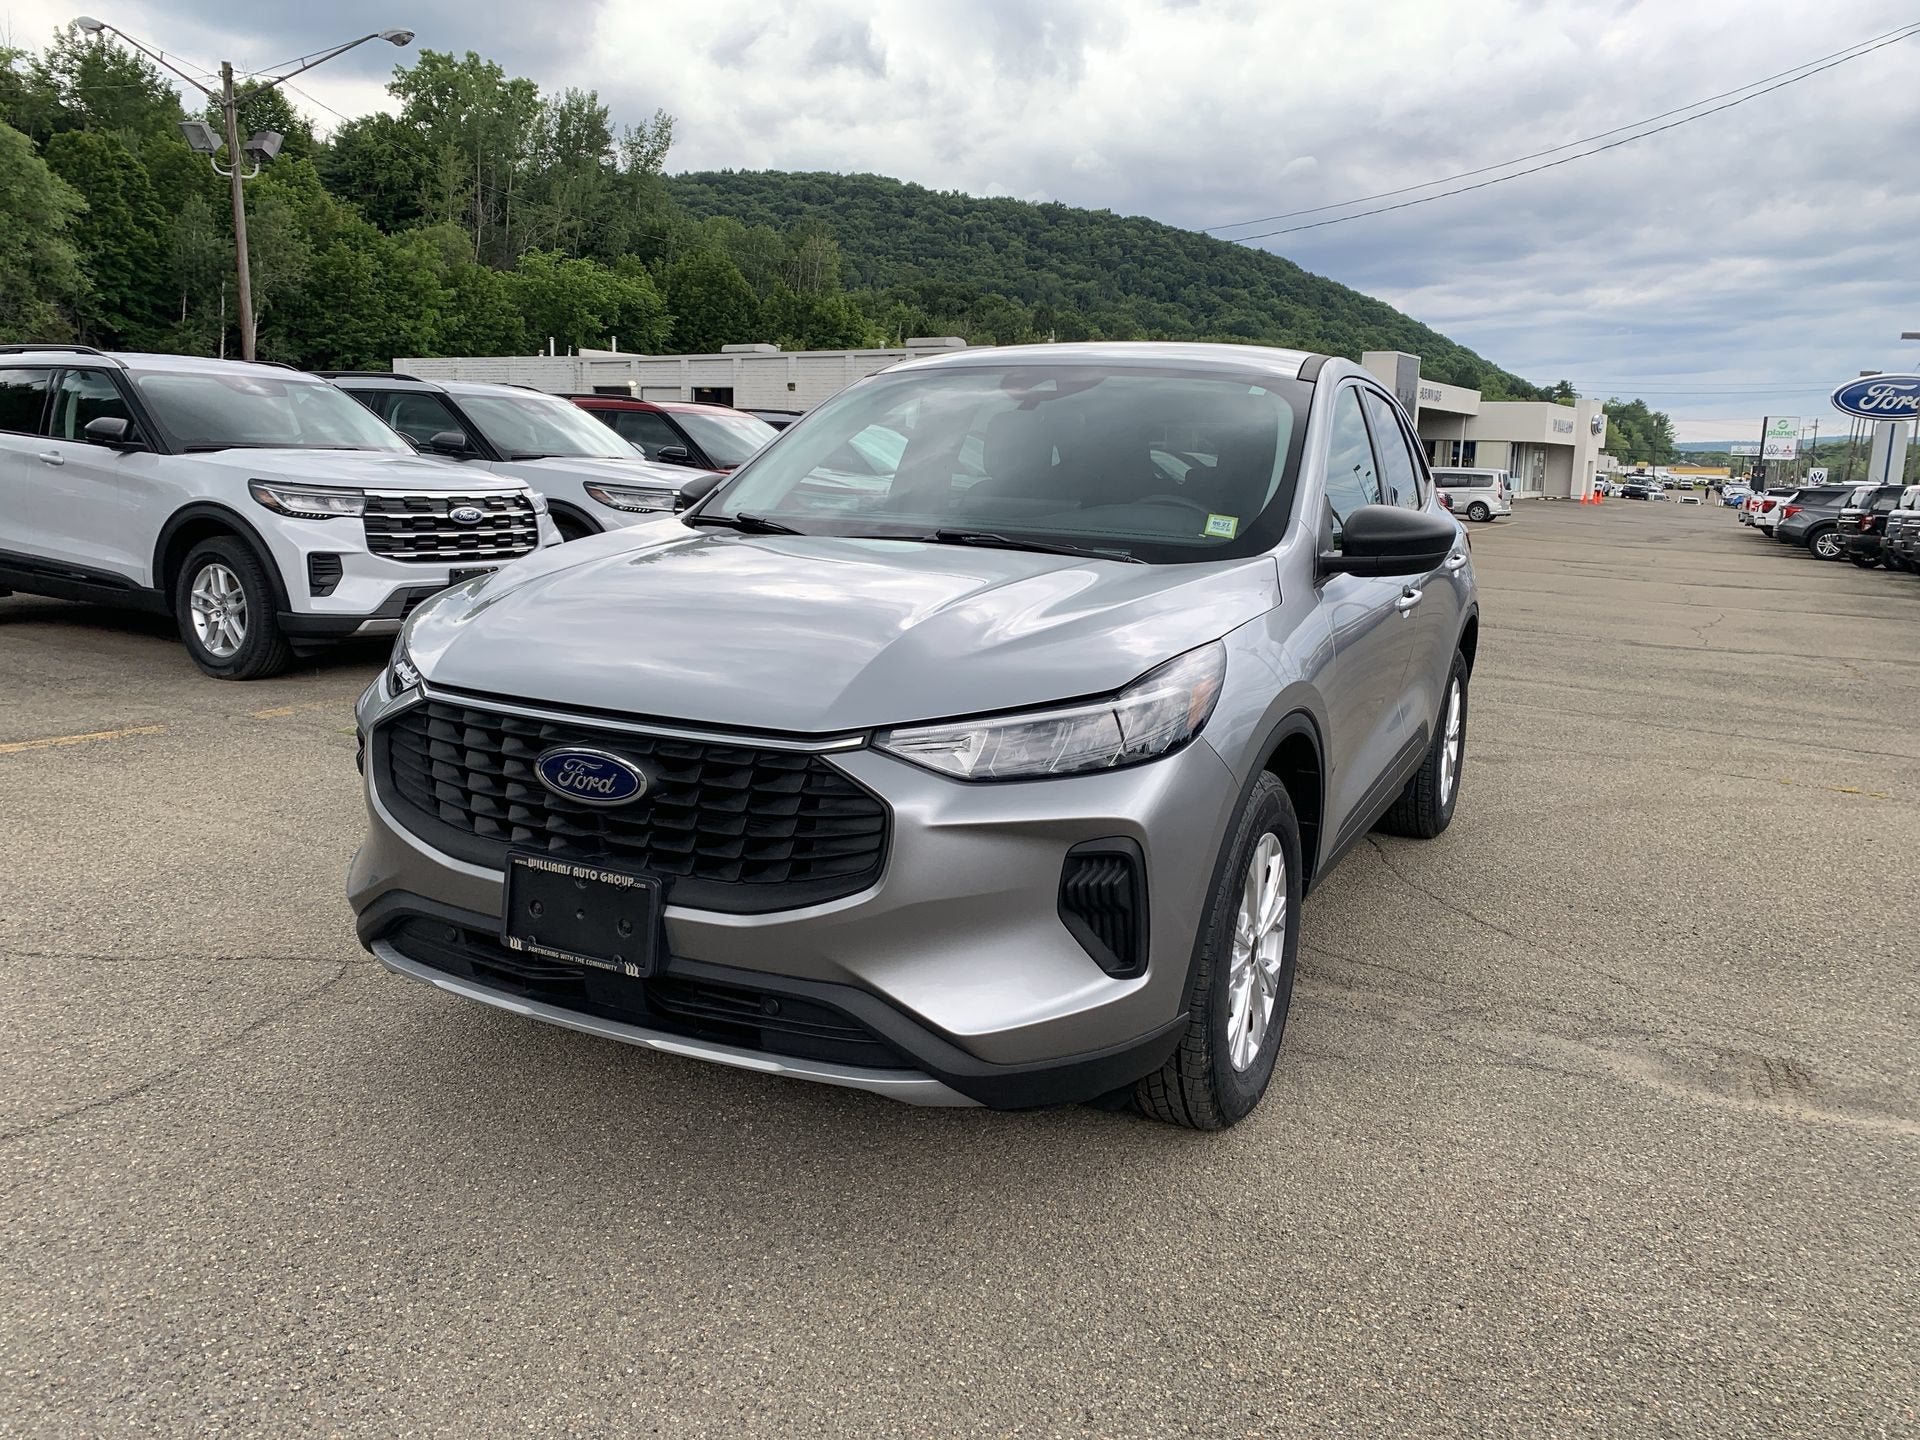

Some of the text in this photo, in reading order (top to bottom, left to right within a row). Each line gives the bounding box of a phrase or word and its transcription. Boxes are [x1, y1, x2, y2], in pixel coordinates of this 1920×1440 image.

[1767, 428, 1798, 438] planet
[459, 510, 478, 520] Ford
[557, 758, 618, 794] Ford
[573, 867, 598, 881] AUTO
[528, 945, 618, 972] PARTNERING WITH THE COMMUNITY
